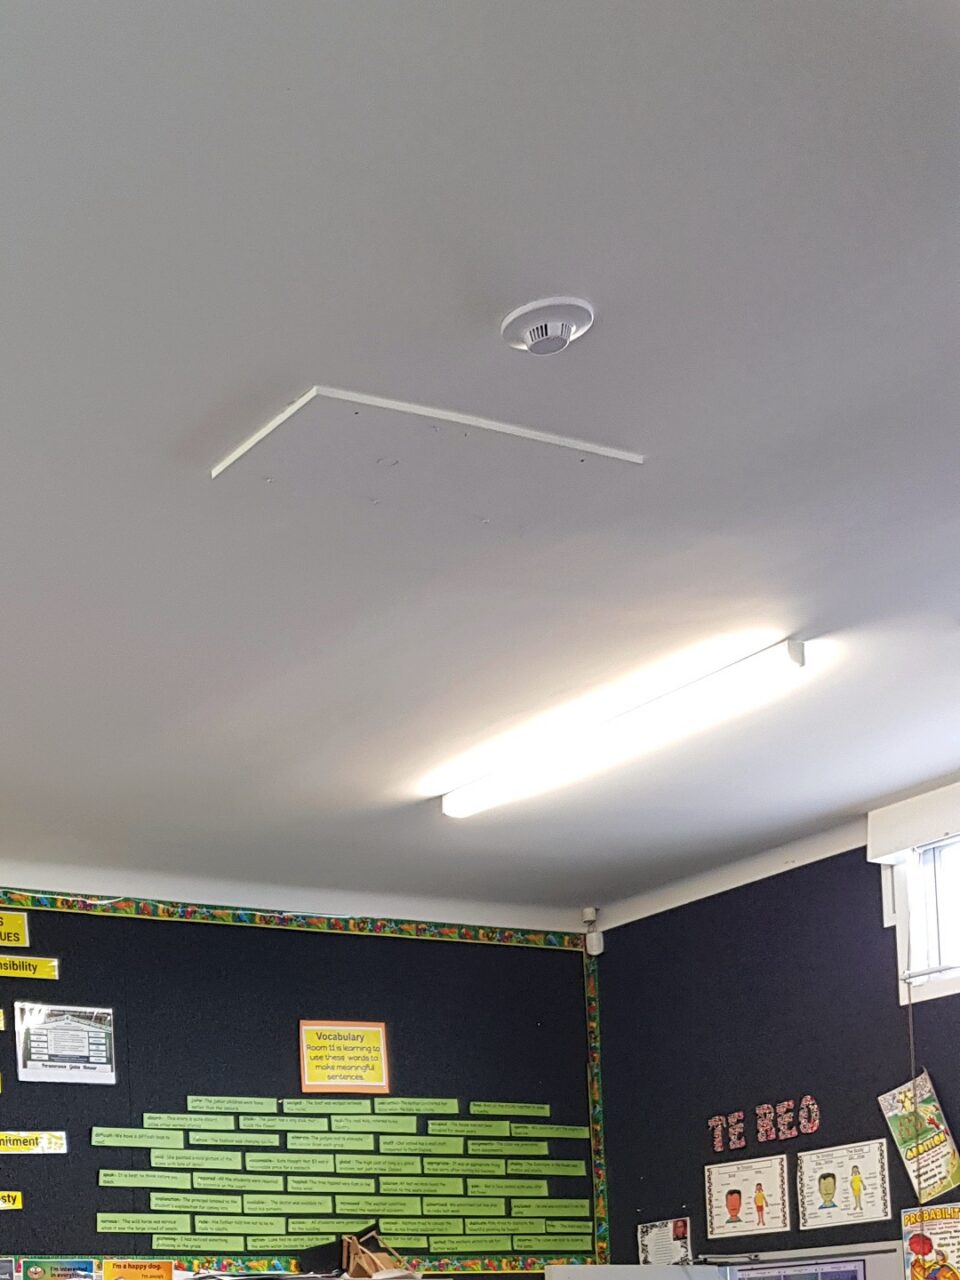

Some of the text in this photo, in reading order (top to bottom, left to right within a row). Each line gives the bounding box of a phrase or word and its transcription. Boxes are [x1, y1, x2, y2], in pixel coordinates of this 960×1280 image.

[316, 1032, 365, 1043] Vocabulary
[343, 1045, 371, 1053] learning
[708, 1095, 820, 1152] TE REO
[906, 1131, 947, 1161] ADDITION
